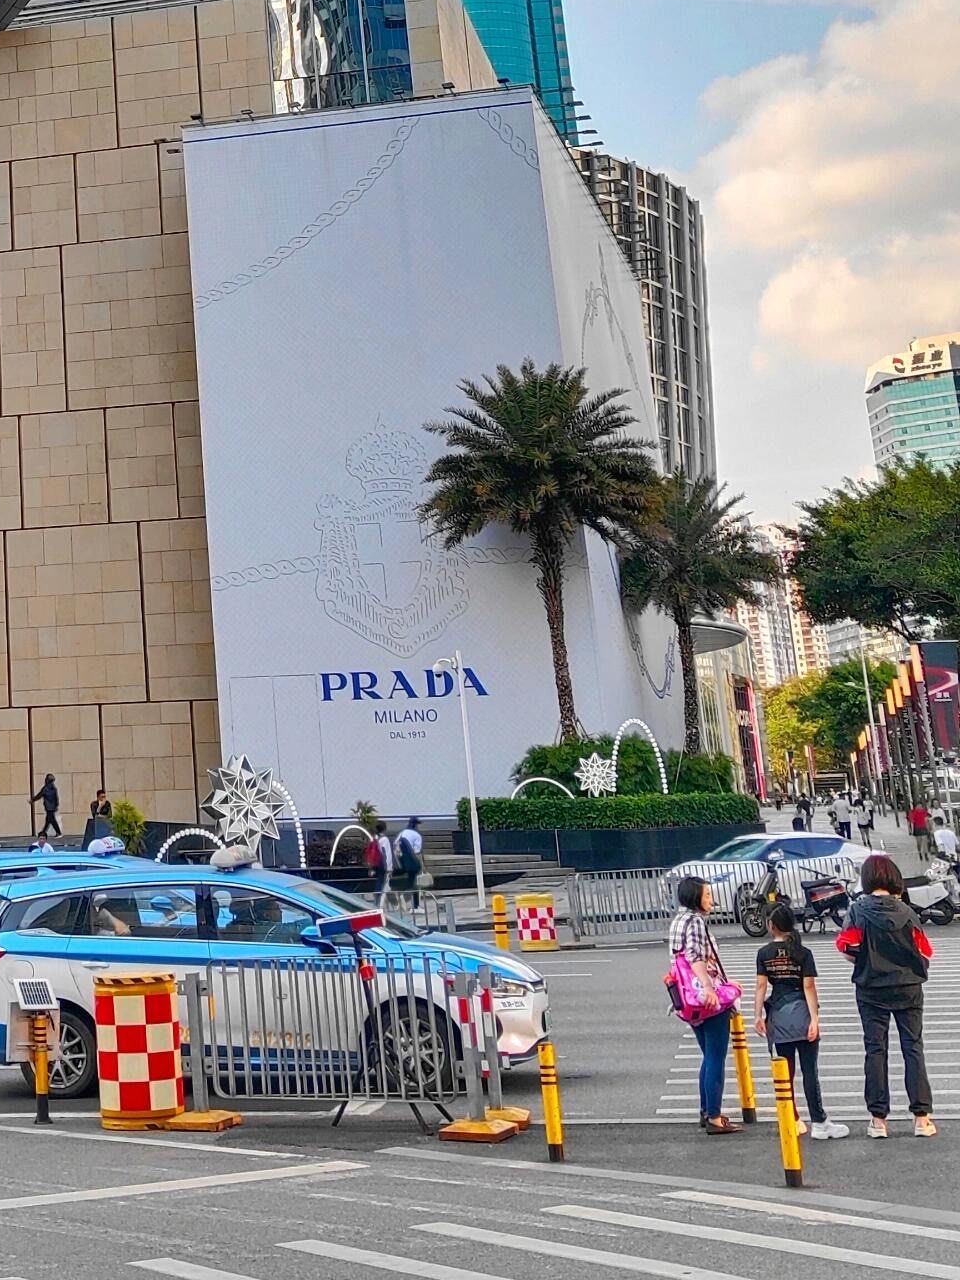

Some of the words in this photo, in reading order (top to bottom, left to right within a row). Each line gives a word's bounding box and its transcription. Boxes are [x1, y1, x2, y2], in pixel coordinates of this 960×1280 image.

[319, 667, 489, 701] PRADA
[374, 709, 438, 724] MILANO
[390, 732, 406, 740] DAL
[408, 731, 426, 739] 1913
